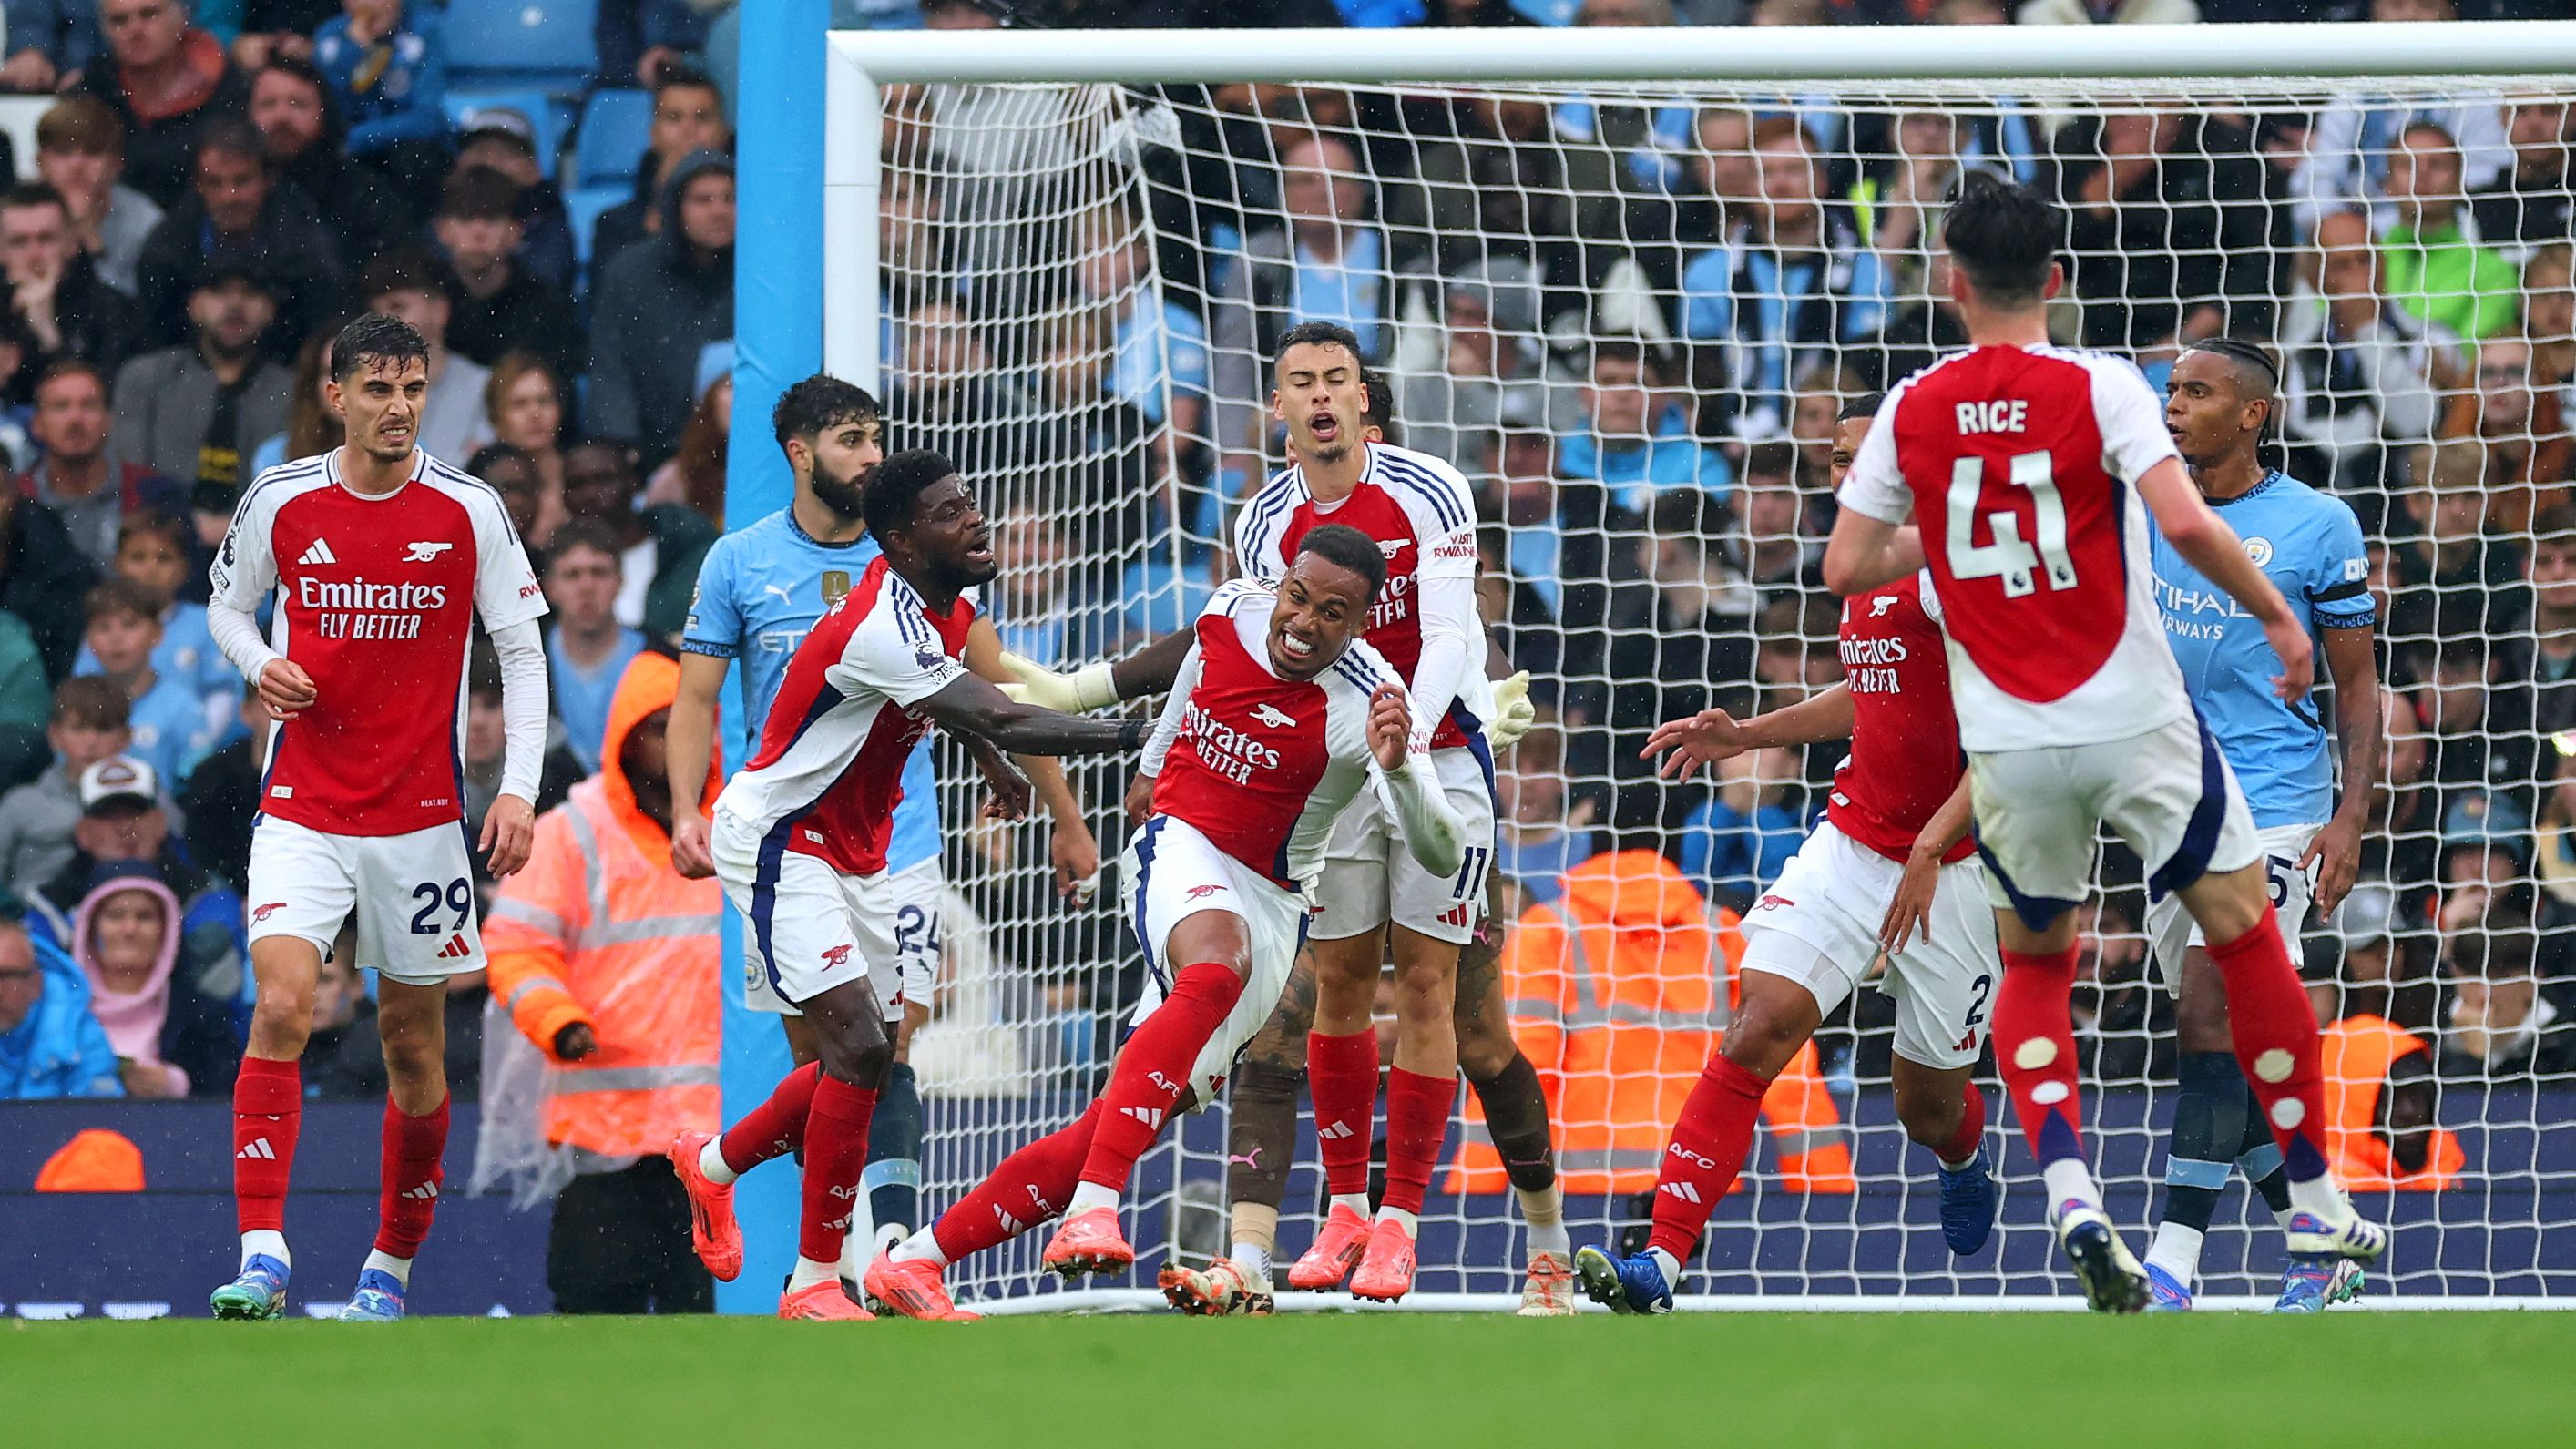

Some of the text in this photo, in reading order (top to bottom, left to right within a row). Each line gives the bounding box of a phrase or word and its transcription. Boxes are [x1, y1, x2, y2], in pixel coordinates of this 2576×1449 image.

[1955, 399, 2029, 435] RICE
[1946, 449, 2079, 599] 41
[299, 576, 446, 610] Emirates
[320, 613, 422, 640] FLY BETTER
[1196, 737, 1252, 786] BETTER
[1452, 845, 1488, 901] 11
[2265, 853, 2294, 909] 5
[411, 877, 472, 934] 29
[1965, 974, 1992, 1027] 2
[1668, 1141, 1716, 1170] AFC
